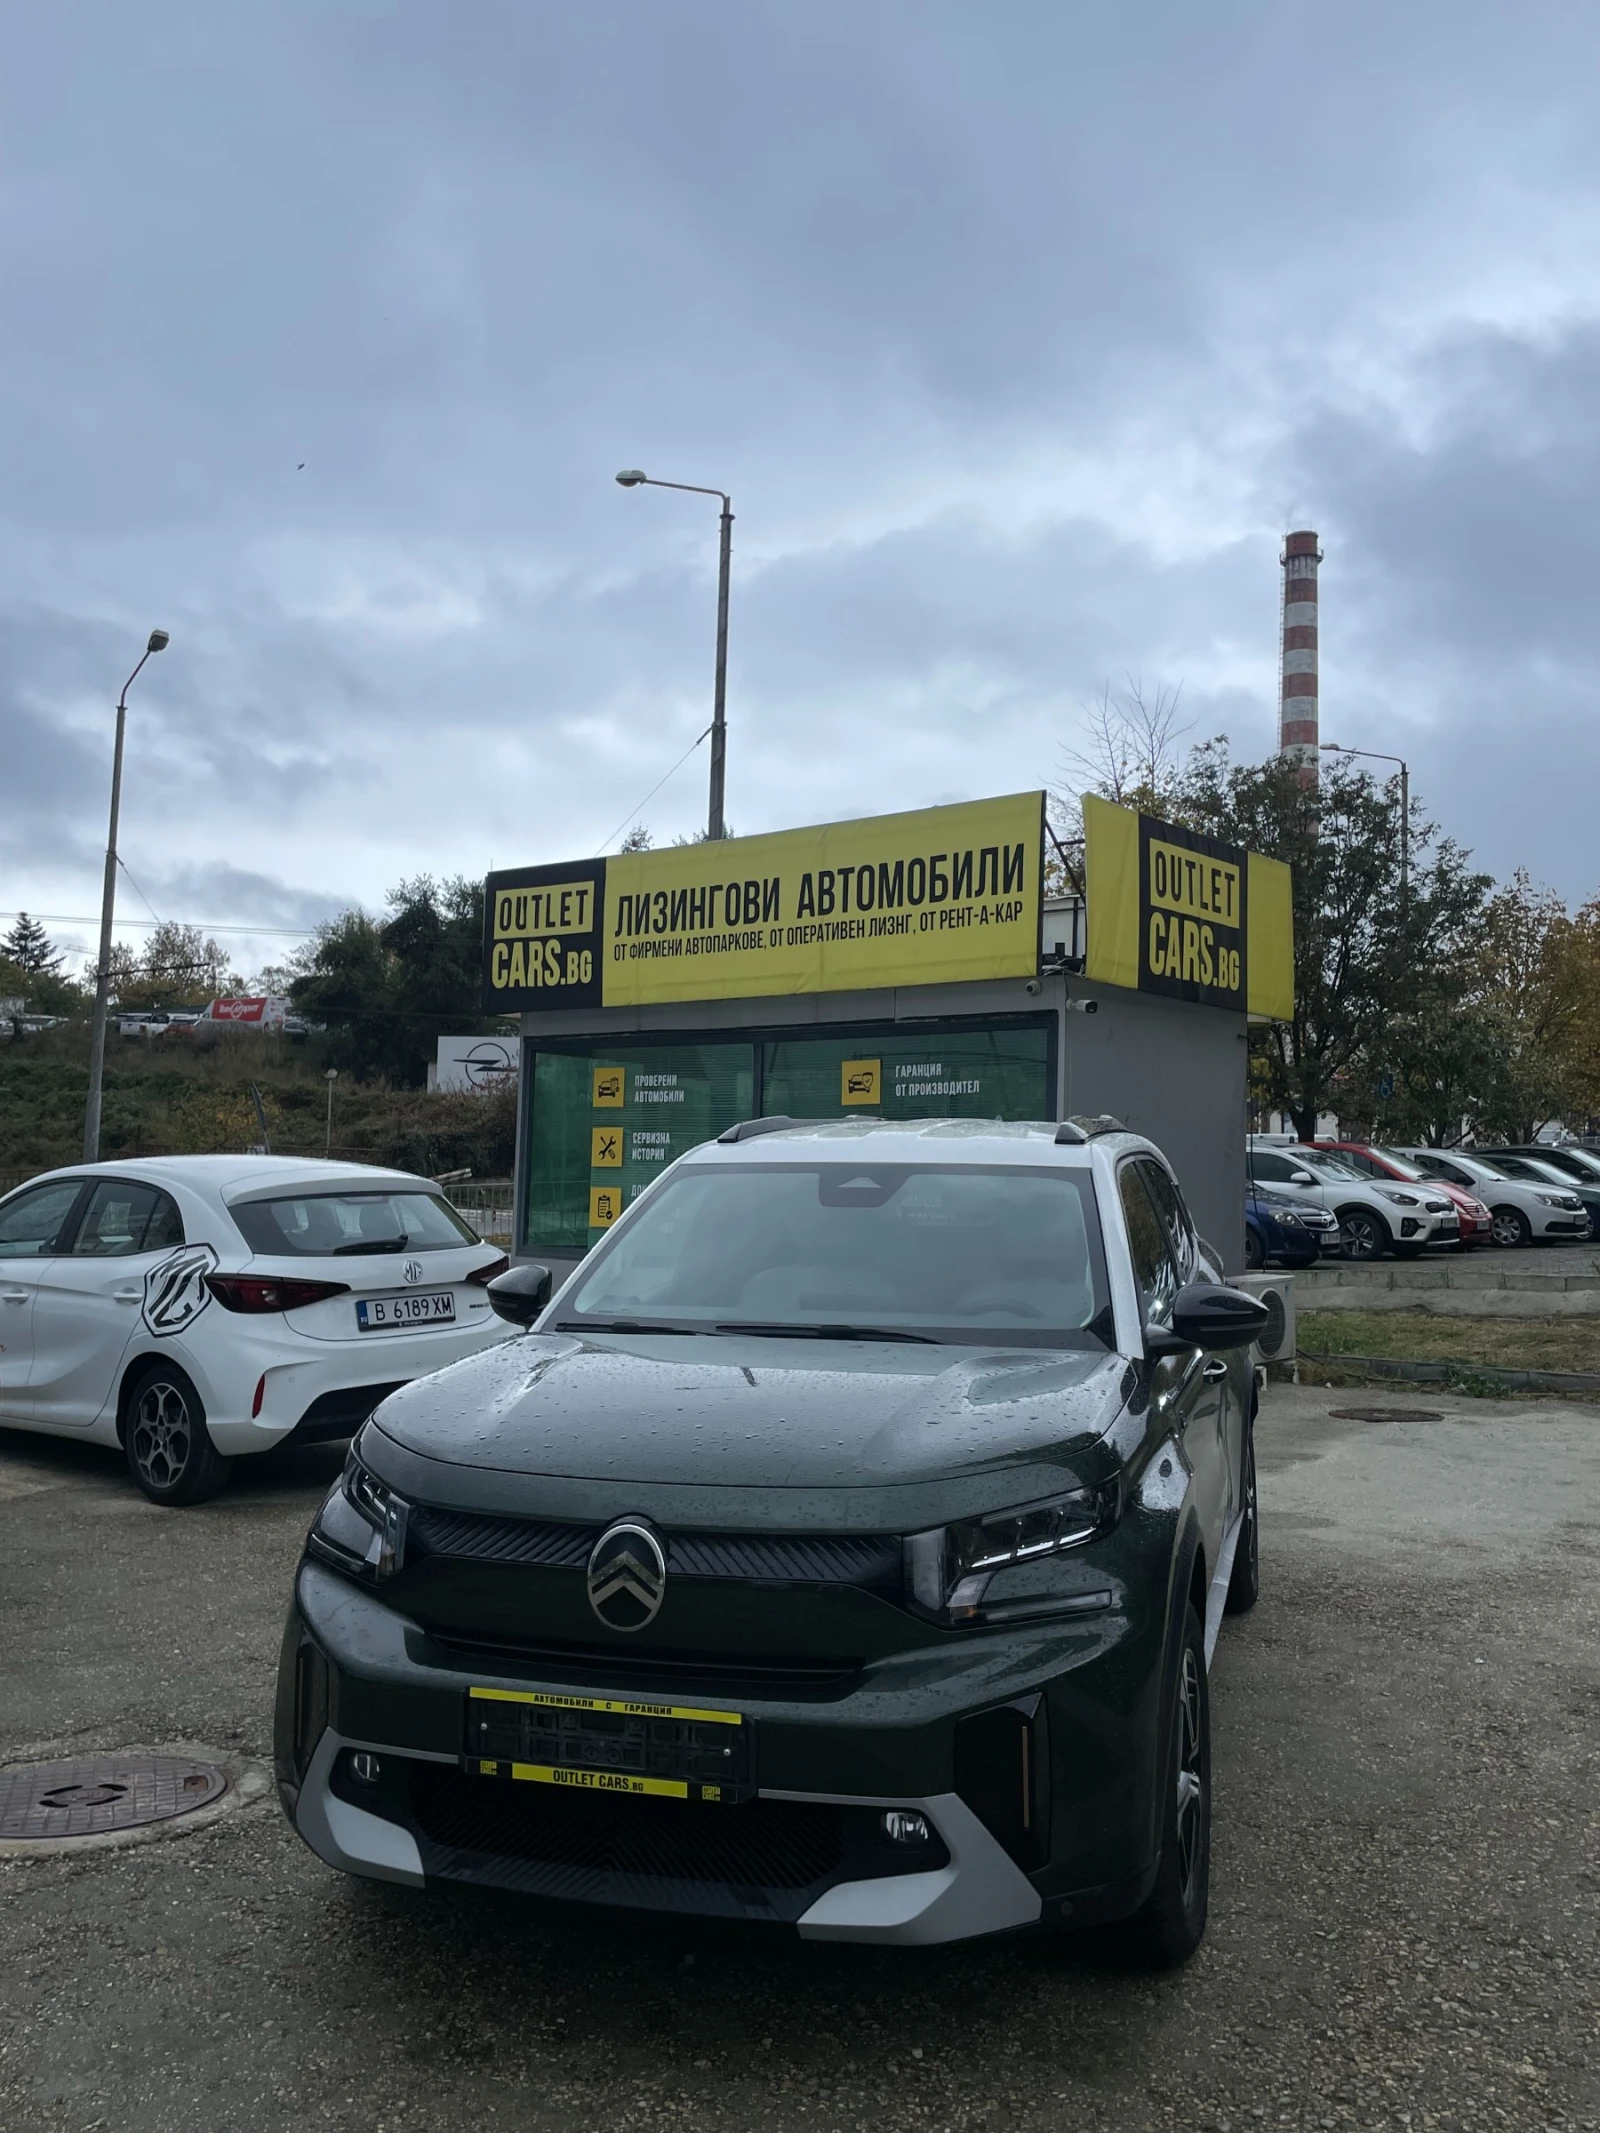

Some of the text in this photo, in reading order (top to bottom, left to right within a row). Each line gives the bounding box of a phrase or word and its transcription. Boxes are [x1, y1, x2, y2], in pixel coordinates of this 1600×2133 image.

[614, 843, 1025, 938] ЛИЗИНГОВИ АВТОМОБИЛИ
[1155, 850, 1236, 918] OUTLET
[499, 889, 589, 932] OUTLET
[614, 943, 627, 962] ОТ
[629, 938, 683, 961] ФИРМЕНИ
[684, 930, 767, 957] АВТОПАРКОВЕ,
[769, 928, 785, 948] ОТ
[786, 918, 865, 947] ОПЕРАТИВЕН
[919, 911, 937, 932] ОТ
[939, 900, 1024, 931] РЕНТ-А-КАР
[1149, 911, 1241, 992] CARS.BG
[491, 938, 593, 989] CARS.BG
[634, 1074, 678, 1087] ПРОВЕРЕНИ
[895, 1063, 942, 1078] ГАРАНЦИЯ
[634, 1090, 685, 1103] АВТОМОБИЛИ
[895, 1080, 980, 1097] ОТ ПРОИЗВОДИТЕЛ
[632, 1132, 671, 1144] СЕРВИЗНА
[631, 1148, 665, 1161] ИСТОРИЯ
[404, 1260, 423, 1283] MG
[394, 1299, 429, 1319] 6189
[534, 1694, 594, 1708] АВТОМОБИЛИ
[624, 1704, 672, 1716] ГАРАНЦИЯ
[553, 1770, 644, 1792] OUTLET CARS.BG
